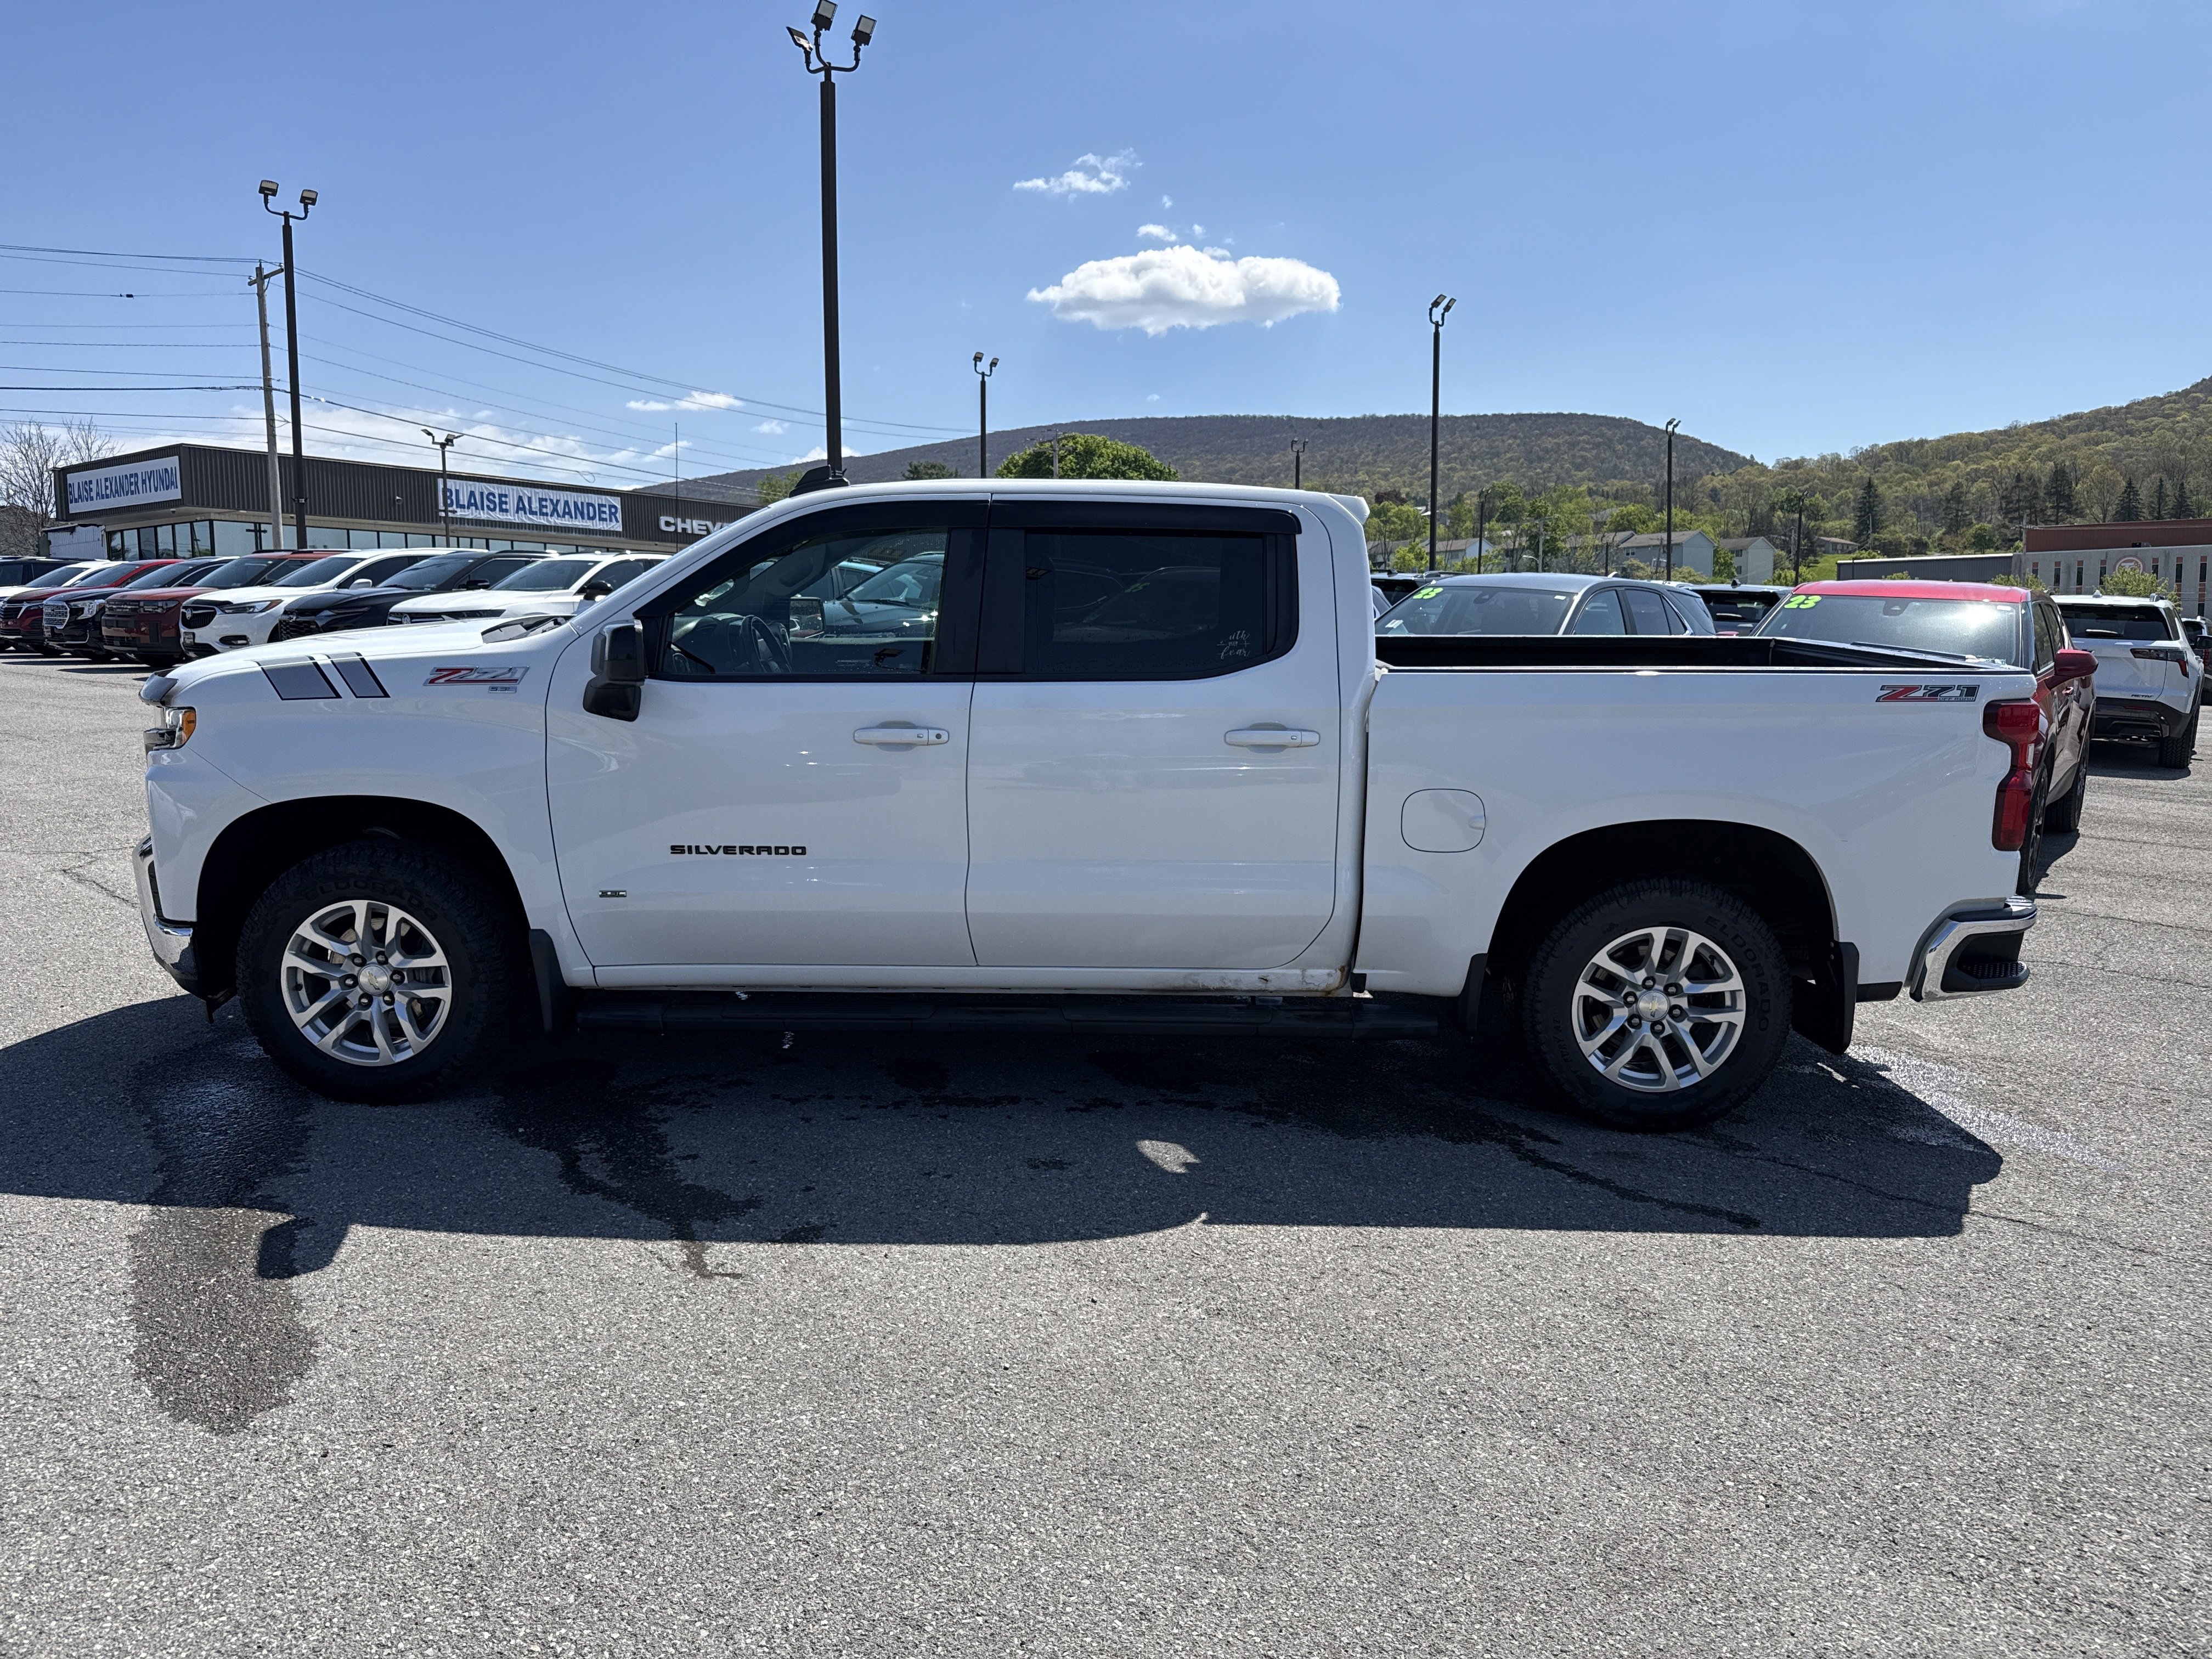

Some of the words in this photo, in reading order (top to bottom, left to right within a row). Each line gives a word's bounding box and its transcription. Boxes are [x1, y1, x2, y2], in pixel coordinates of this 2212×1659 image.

[69, 480, 94, 504] BLAISE
[96, 473, 140, 500] ALEXANDER
[141, 466, 178, 493] HYUNDAI
[443, 488, 509, 513] BLAISE
[516, 495, 619, 522] ALEXANDER
[659, 516, 729, 535] CHEV
[1413, 588, 1443, 599] 23
[1784, 595, 1821, 608] 23
[424, 667, 529, 686] Z71
[1875, 685, 1980, 702] Z71
[670, 845, 806, 855] SILVERADO
[1705, 916, 1770, 1032] ELDORADO
